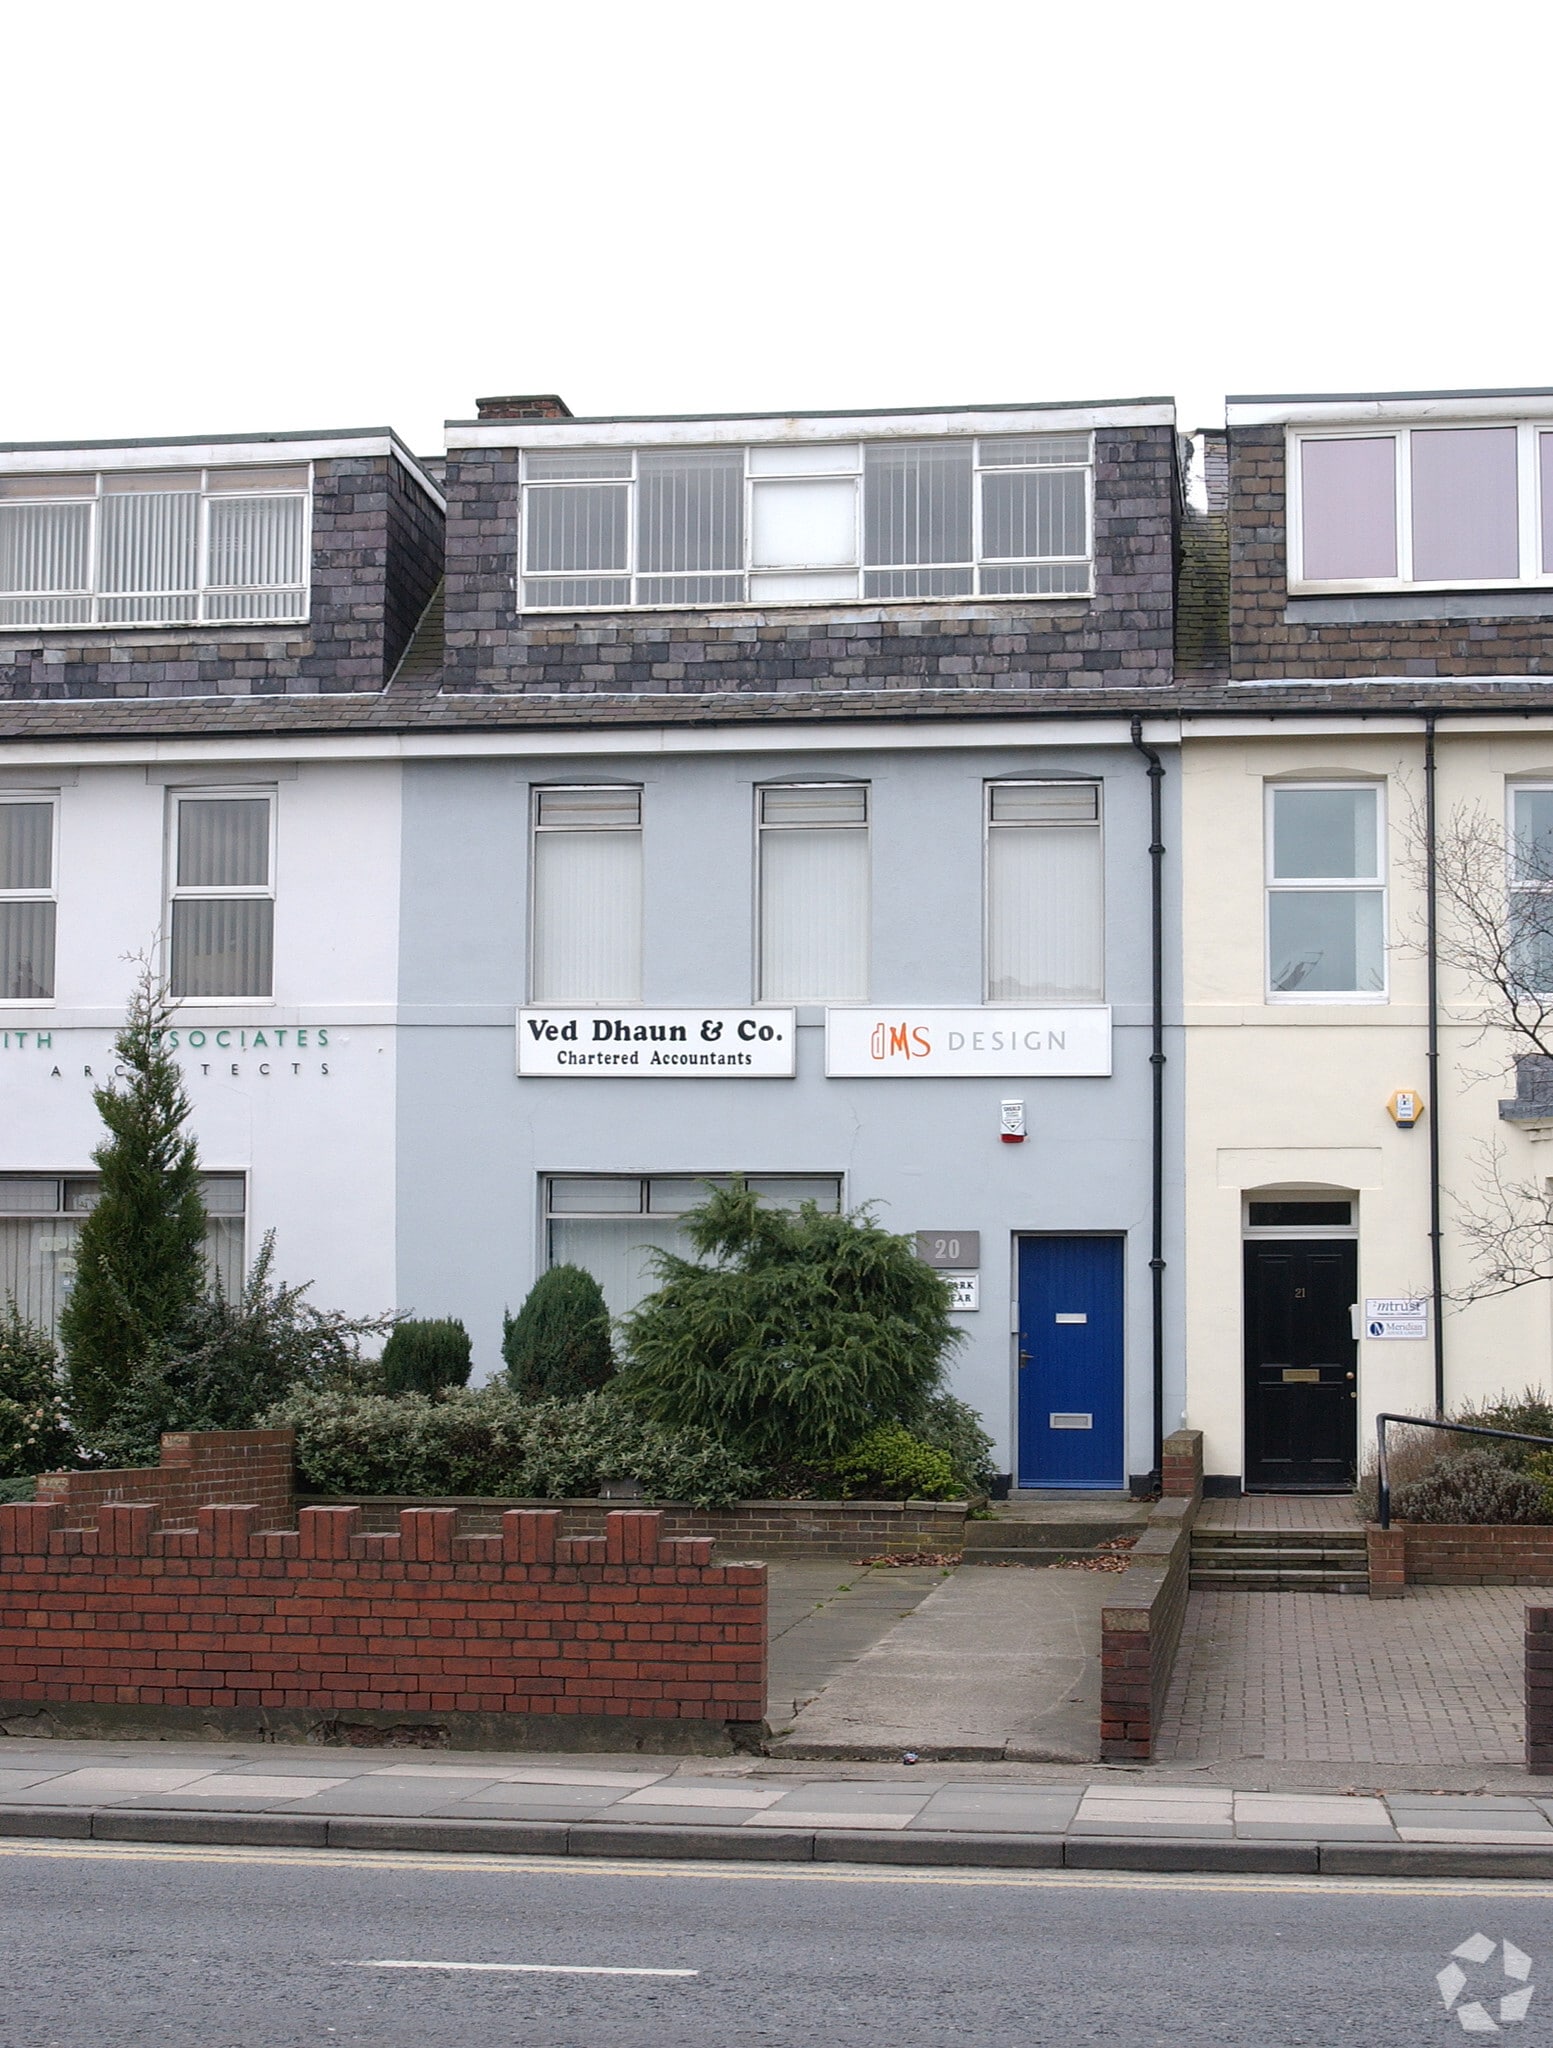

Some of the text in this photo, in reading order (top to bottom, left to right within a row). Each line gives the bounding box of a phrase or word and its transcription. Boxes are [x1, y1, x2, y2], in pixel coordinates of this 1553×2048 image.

[128, 1029, 329, 1048] SSOCIATES
[527, 1019, 783, 1042] Ved Dhaun & Co.
[948, 1031, 1066, 1051] DESIGN
[557, 1050, 752, 1066] Chartered Accountants
[51, 1063, 330, 1077] ARCITECTS
[935, 1239, 960, 1259] 20
[1294, 1287, 1306, 1298] 21
